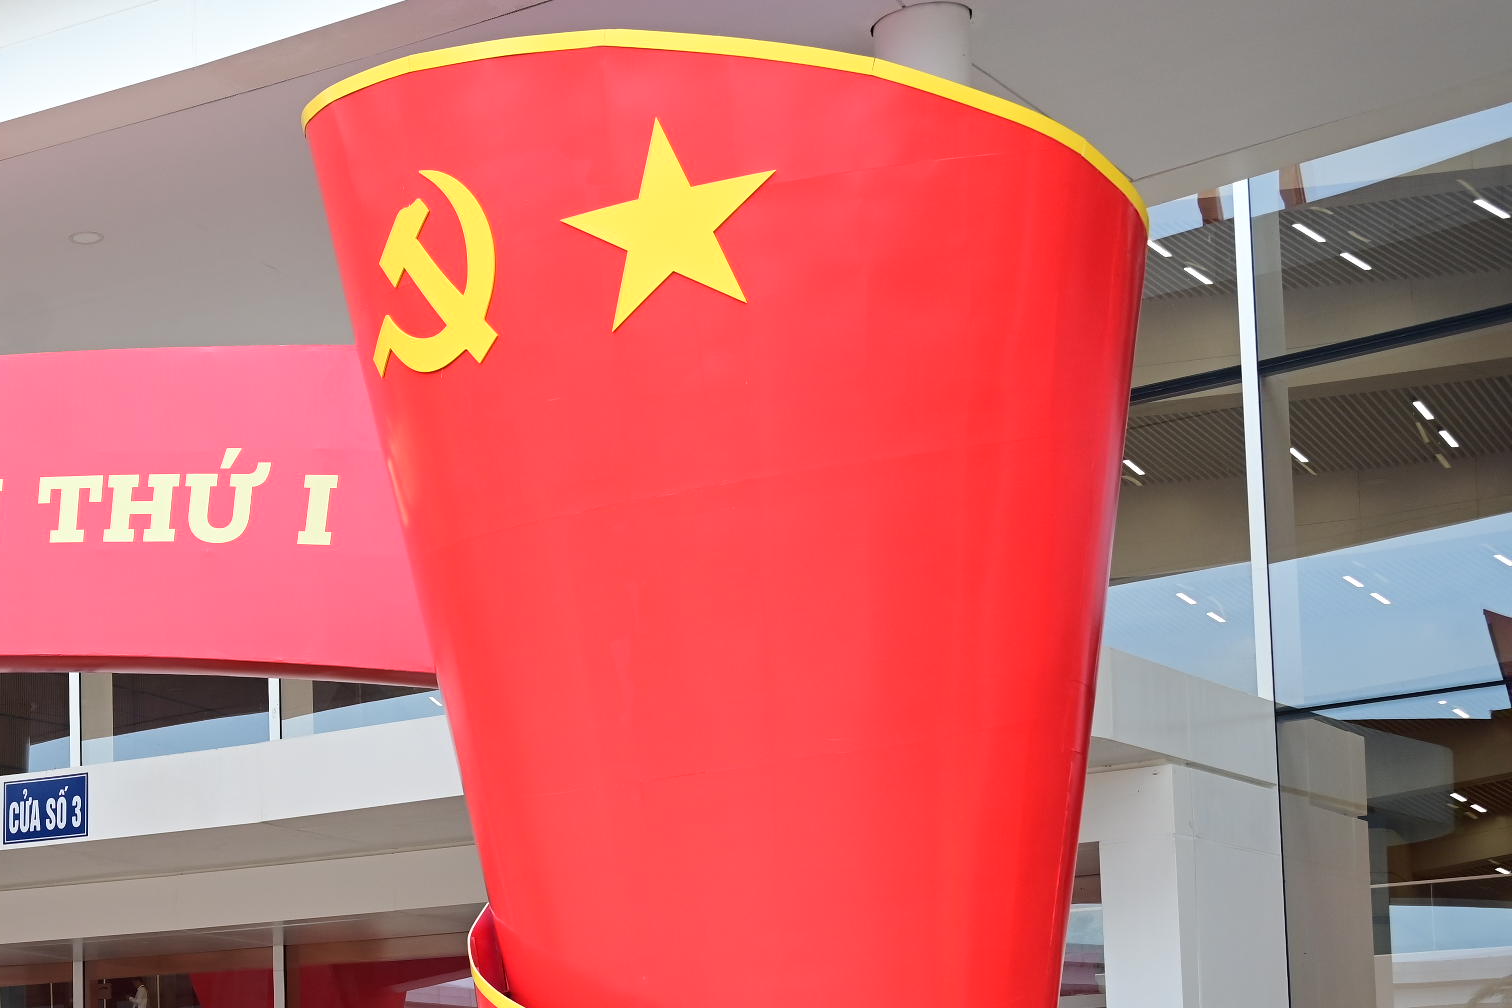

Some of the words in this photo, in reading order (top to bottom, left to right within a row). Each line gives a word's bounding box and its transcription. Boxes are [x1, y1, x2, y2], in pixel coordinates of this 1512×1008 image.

[38, 447, 272, 544] THỨ
[297, 474, 339, 546] I
[8, 788, 41, 834] CỬA
[45, 785, 69, 830] SỐ
[71, 795, 82, 828] 3
